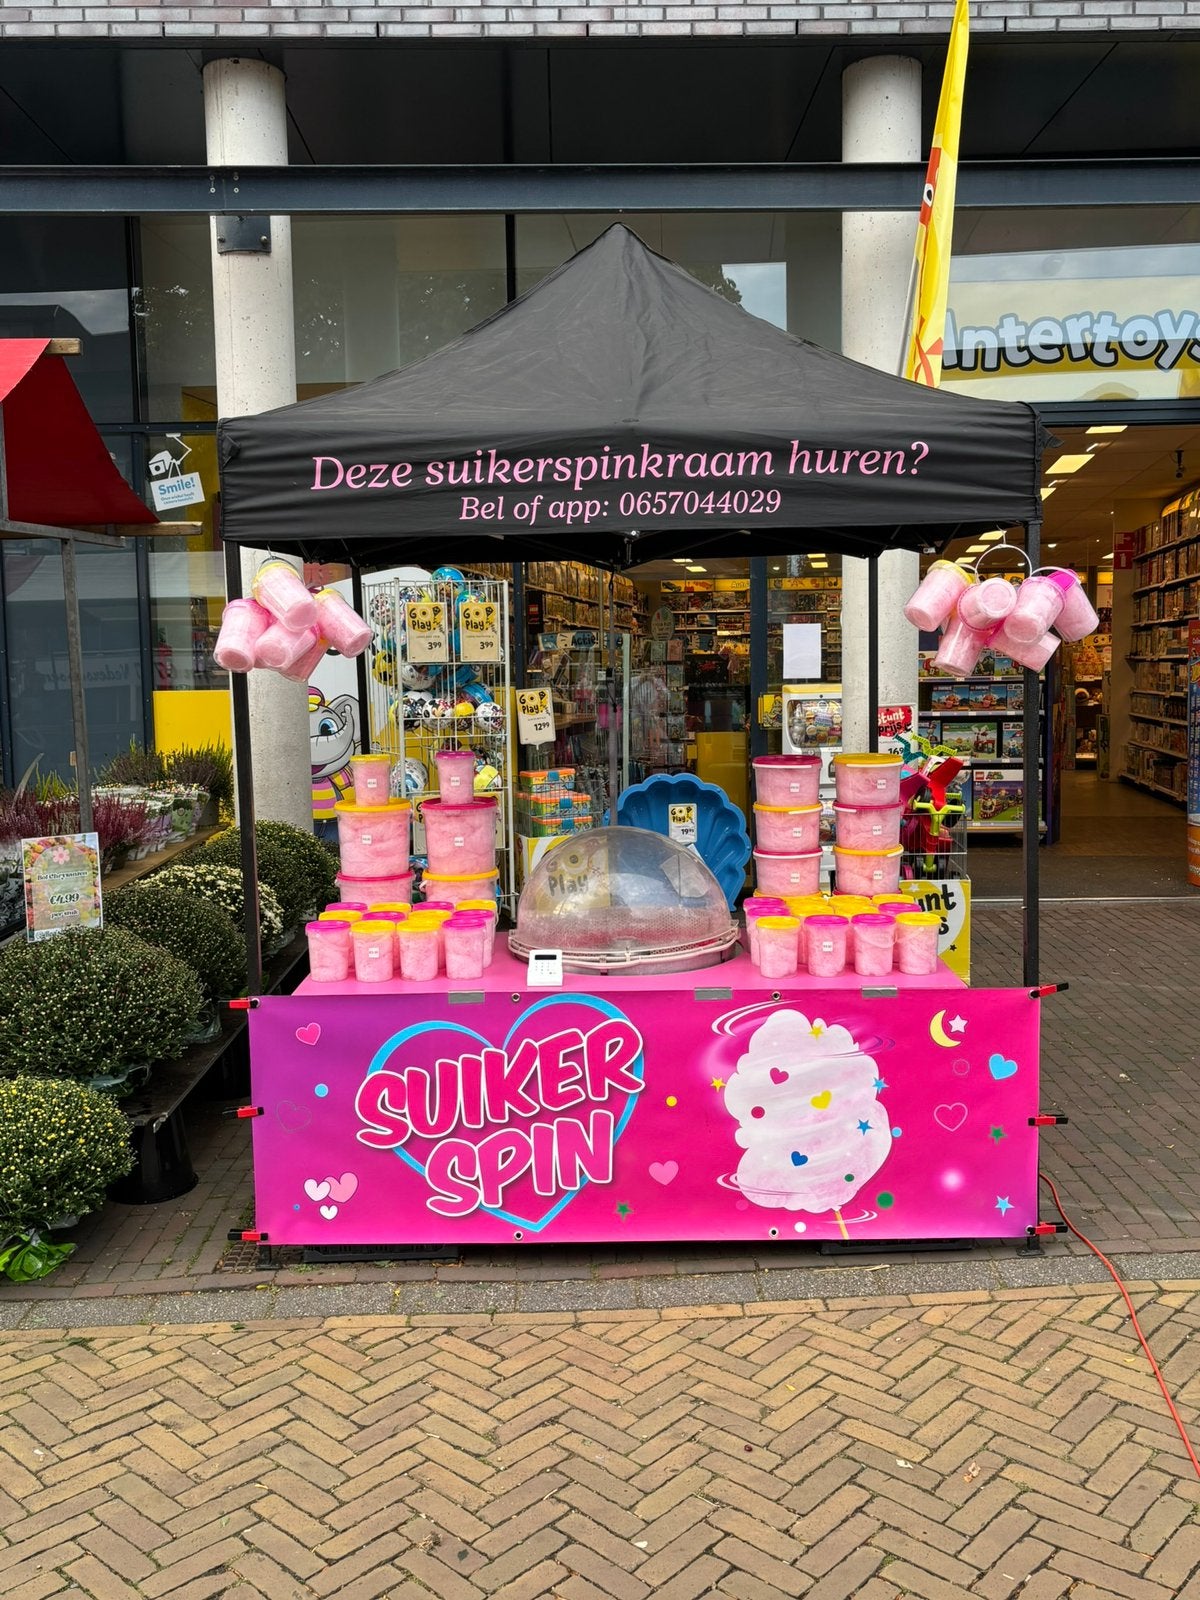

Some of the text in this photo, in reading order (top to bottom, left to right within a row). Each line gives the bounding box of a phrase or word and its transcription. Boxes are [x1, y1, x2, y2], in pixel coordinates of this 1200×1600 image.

[158, 477, 196, 495] Smile!
[310, 439, 930, 491] Deze suikerspinkraam huren?
[459, 489, 782, 526] Bel of app: 0657044029
[355, 1018, 646, 1149] SUIKER
[425, 1109, 614, 1217] SPIN
